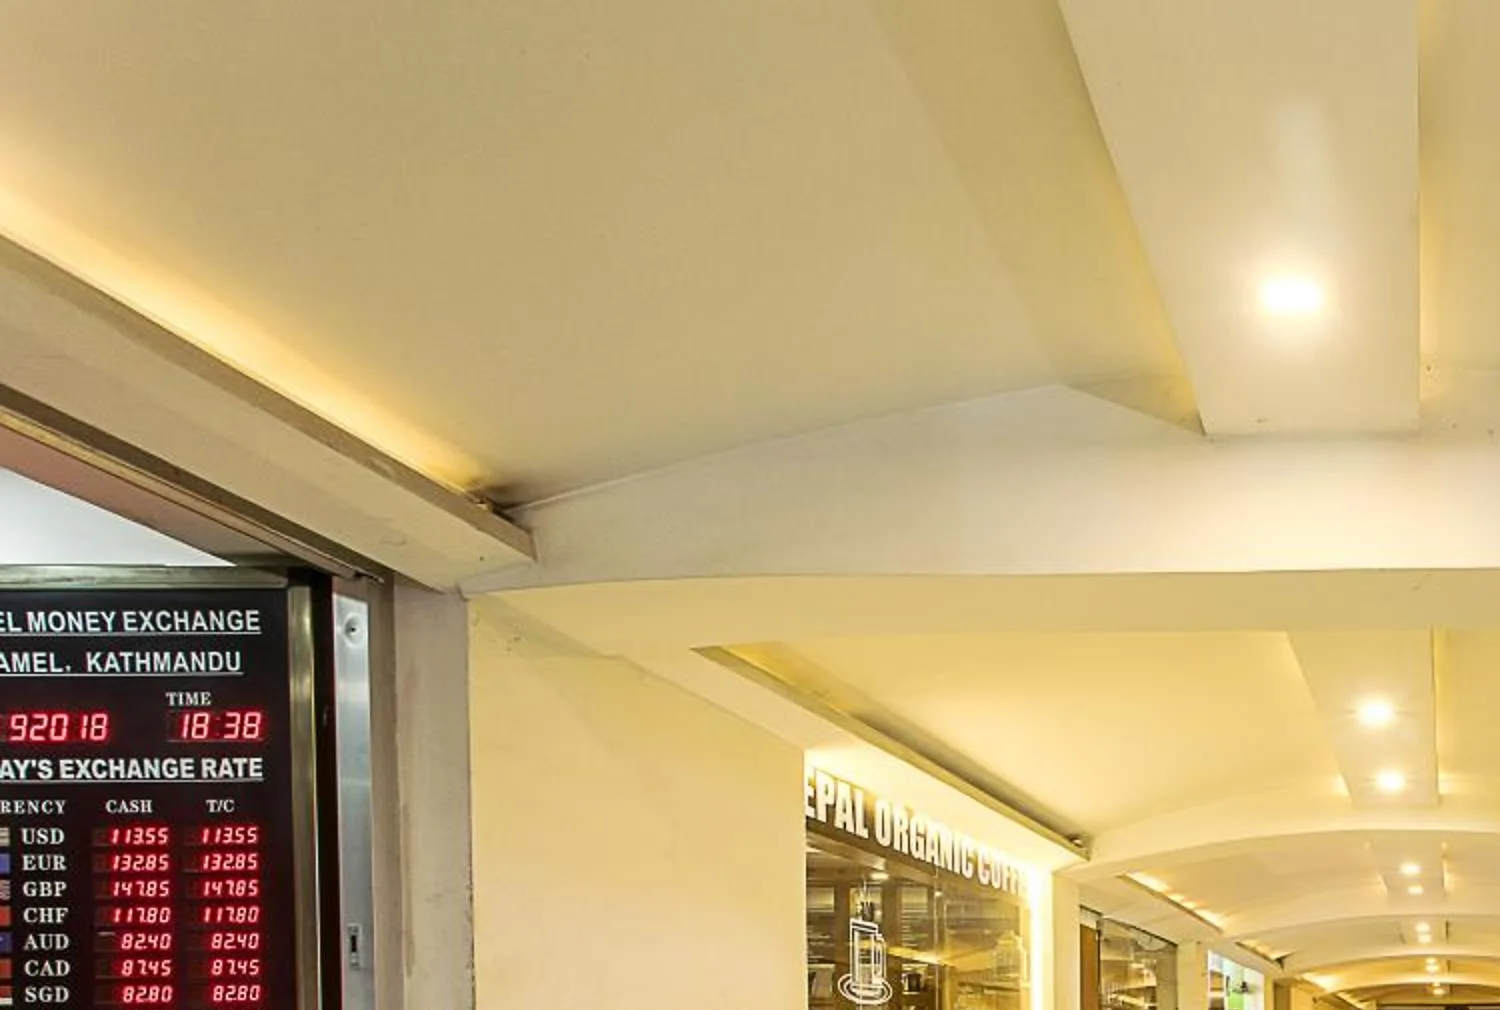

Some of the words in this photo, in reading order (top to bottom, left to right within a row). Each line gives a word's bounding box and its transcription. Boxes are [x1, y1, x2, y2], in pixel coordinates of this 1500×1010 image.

[27, 611, 116, 632] MONEY
[123, 609, 261, 631] EXCHANGE
[86, 651, 242, 673] KATHMANDU
[166, 691, 212, 706] TIME
[180, 711, 262, 740] 18:38
[0, 760, 53, 778] AY'S
[59, 759, 195, 779] EXCHANGE
[201, 758, 263, 778] RATE
[0, 799, 67, 814] RENCY
[105, 799, 153, 814] CASH
[206, 799, 236, 813] T/C
[21, 828, 65, 844] USD
[875, 798, 974, 879] ORGANIC
[22, 855, 67, 870] EUR
[22, 882, 67, 896] GBP
[23, 908, 69, 923] CHF
[24, 934, 69, 949] AUD
[24, 960, 71, 976] CAD
[25, 987, 69, 1002] SGD
